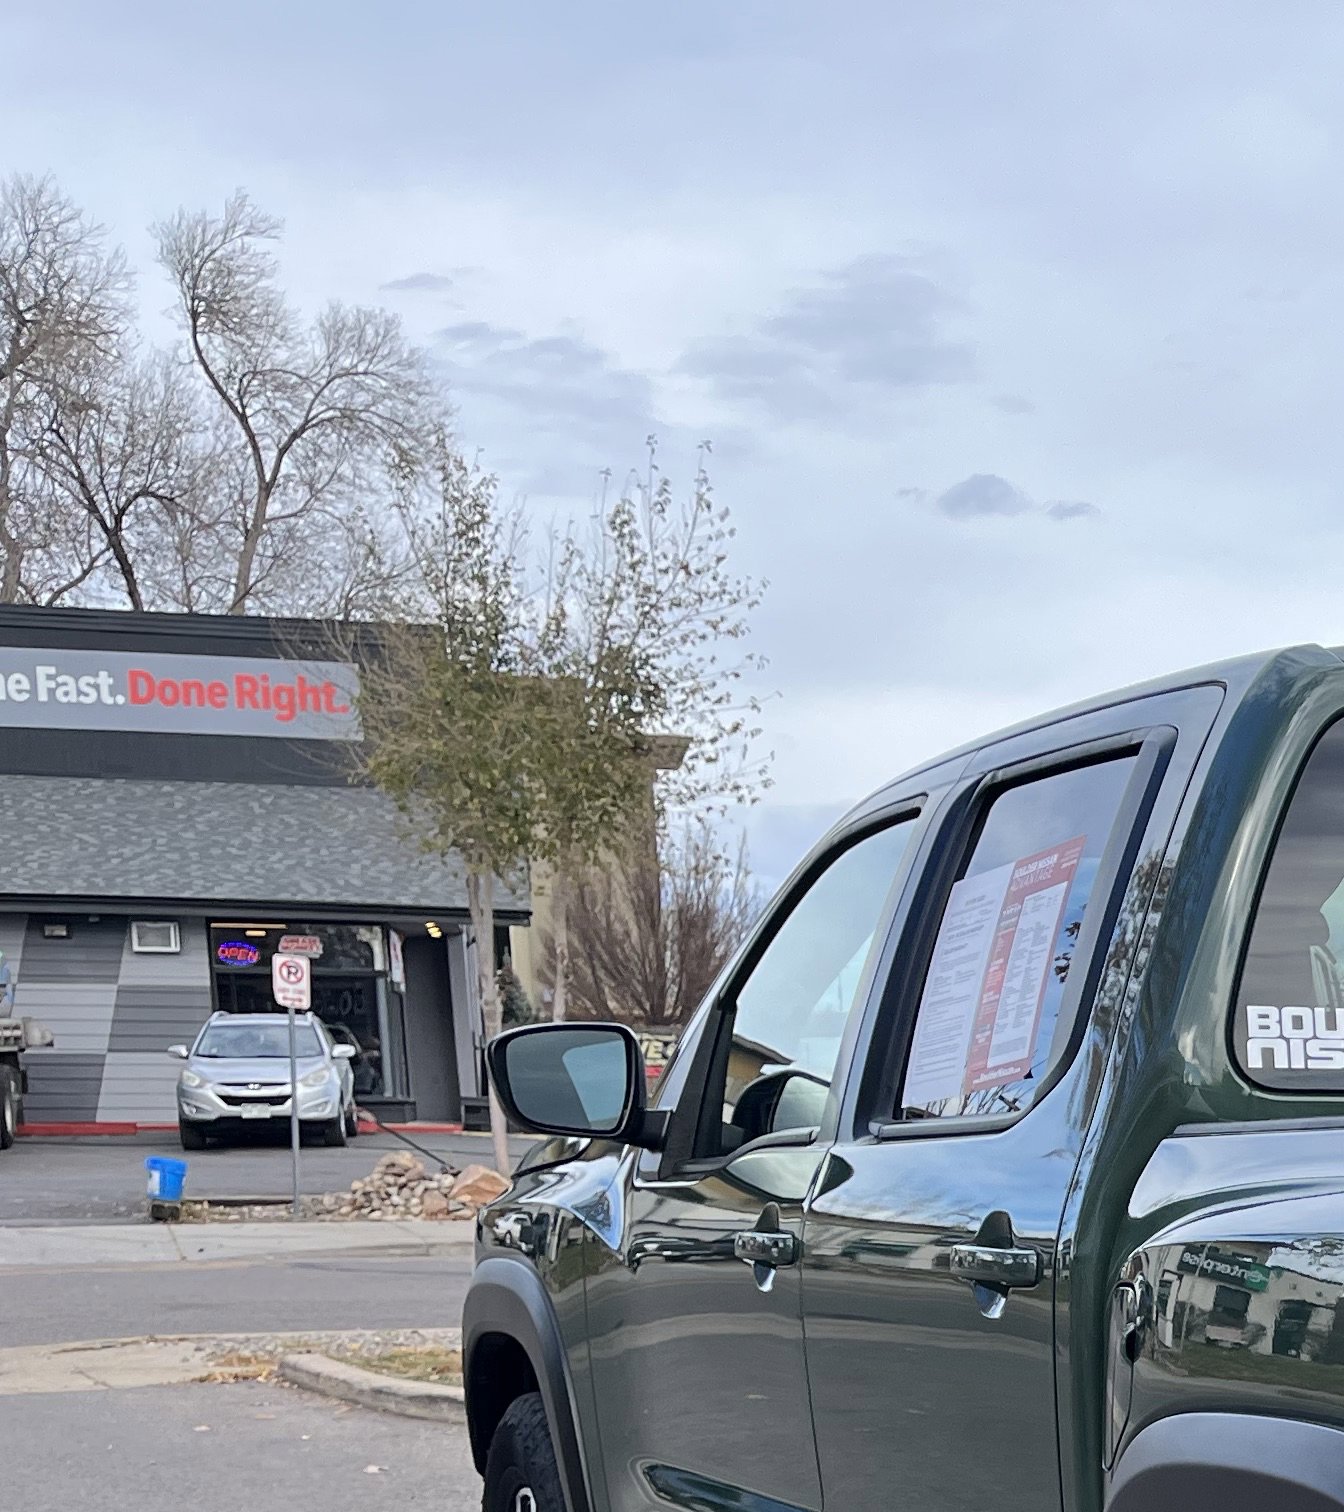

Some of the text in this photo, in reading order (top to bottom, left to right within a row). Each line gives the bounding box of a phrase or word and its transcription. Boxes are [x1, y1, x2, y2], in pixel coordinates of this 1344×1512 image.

[36, 666, 125, 705] Fast.
[128, 669, 227, 708] Done
[234, 673, 349, 721] Right.
[217, 946, 260, 961] OPEN
